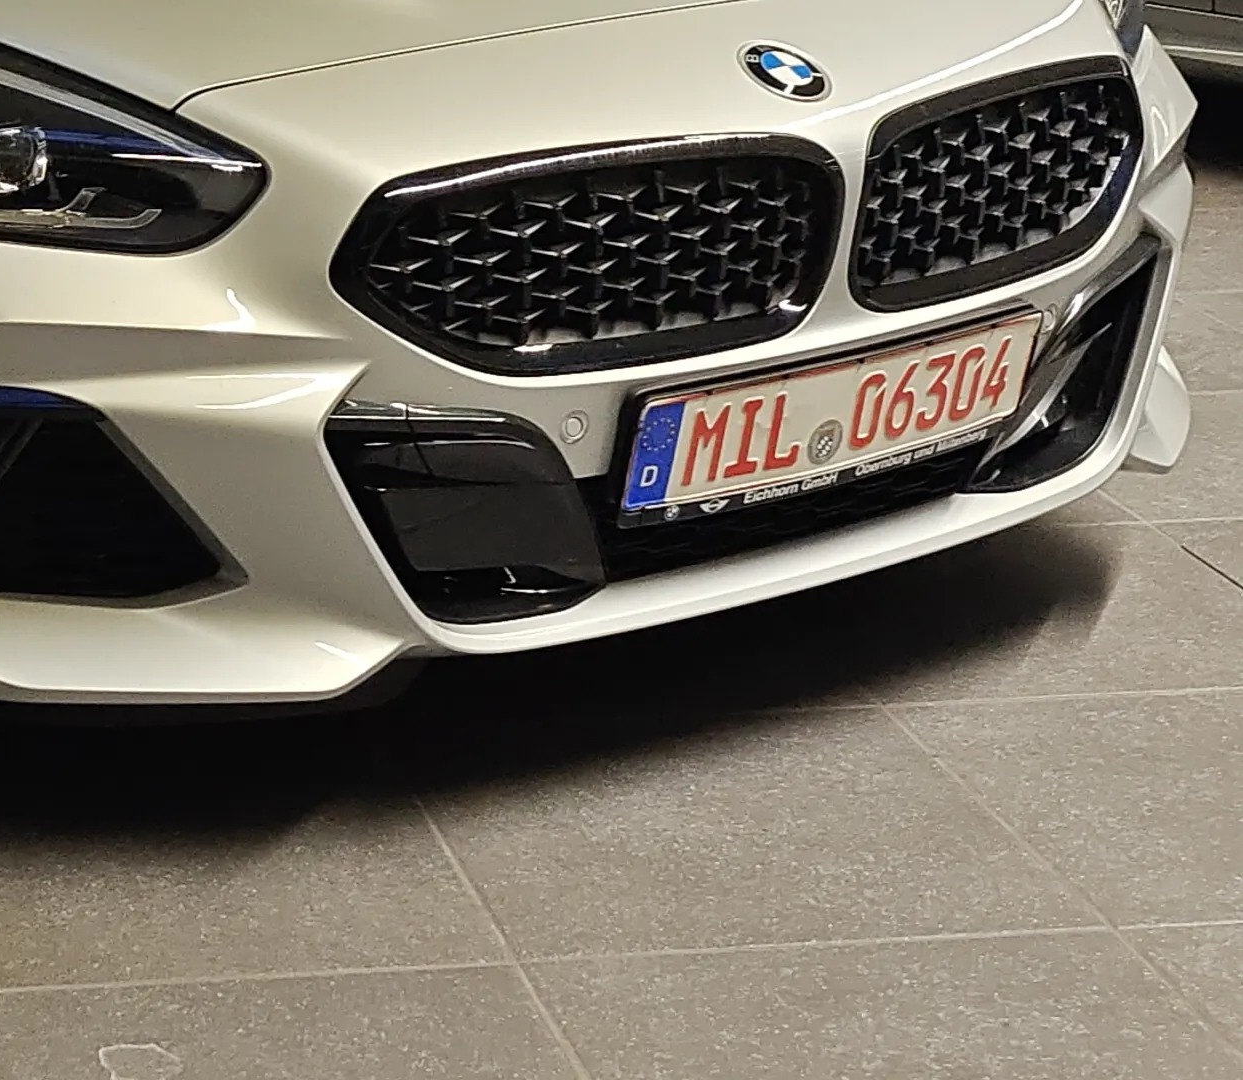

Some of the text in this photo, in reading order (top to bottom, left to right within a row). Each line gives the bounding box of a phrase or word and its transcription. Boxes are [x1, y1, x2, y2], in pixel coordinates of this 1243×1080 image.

[681, 336, 1012, 487] MIL 06304
[640, 465, 658, 487] D
[743, 481, 799, 505] Eichhorn
[801, 472, 839, 491] GmbH
